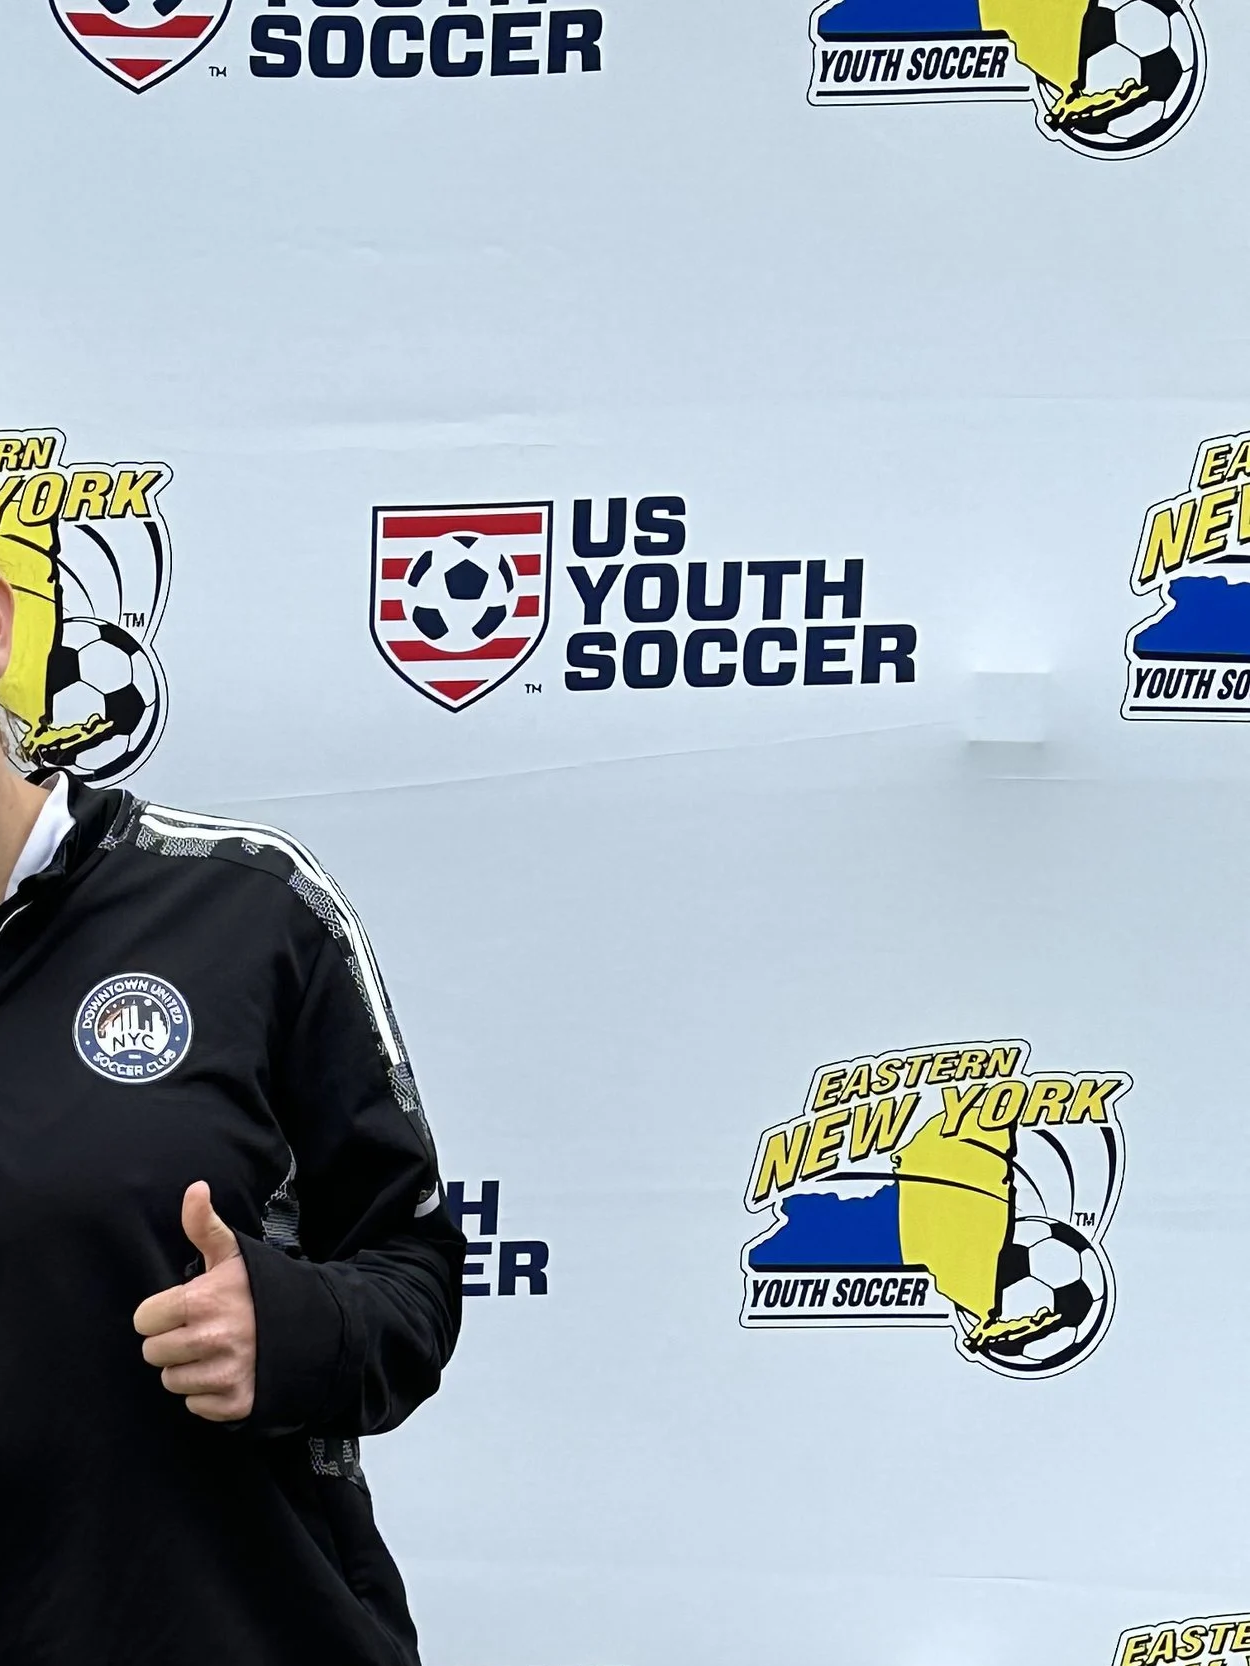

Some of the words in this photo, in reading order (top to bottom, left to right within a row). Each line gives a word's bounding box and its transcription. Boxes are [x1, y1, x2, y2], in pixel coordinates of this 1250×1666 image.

[250, 9, 603, 78] SOCCER
[819, 48, 904, 83] YOUTH
[907, 46, 1009, 80] SOCCER
[571, 495, 687, 559] US
[1138, 485, 1250, 586] NE
[564, 558, 864, 627] YOUTH
[564, 623, 916, 692] SOCCER
[1133, 668, 1216, 700] YOUTH
[82, 979, 149, 1029] DOWNTOWN
[151, 984, 184, 1025] UNITED
[93, 1051, 143, 1076] SOCCER
[146, 1049, 177, 1073] CLUB
[113, 1032, 155, 1052] NYC
[813, 1047, 1021, 1112] EASTERN
[753, 1093, 921, 1203] NEW
[939, 1079, 1124, 1138] YORK
[751, 1278, 830, 1308] YOUTH
[833, 1277, 929, 1308] SOCCER
